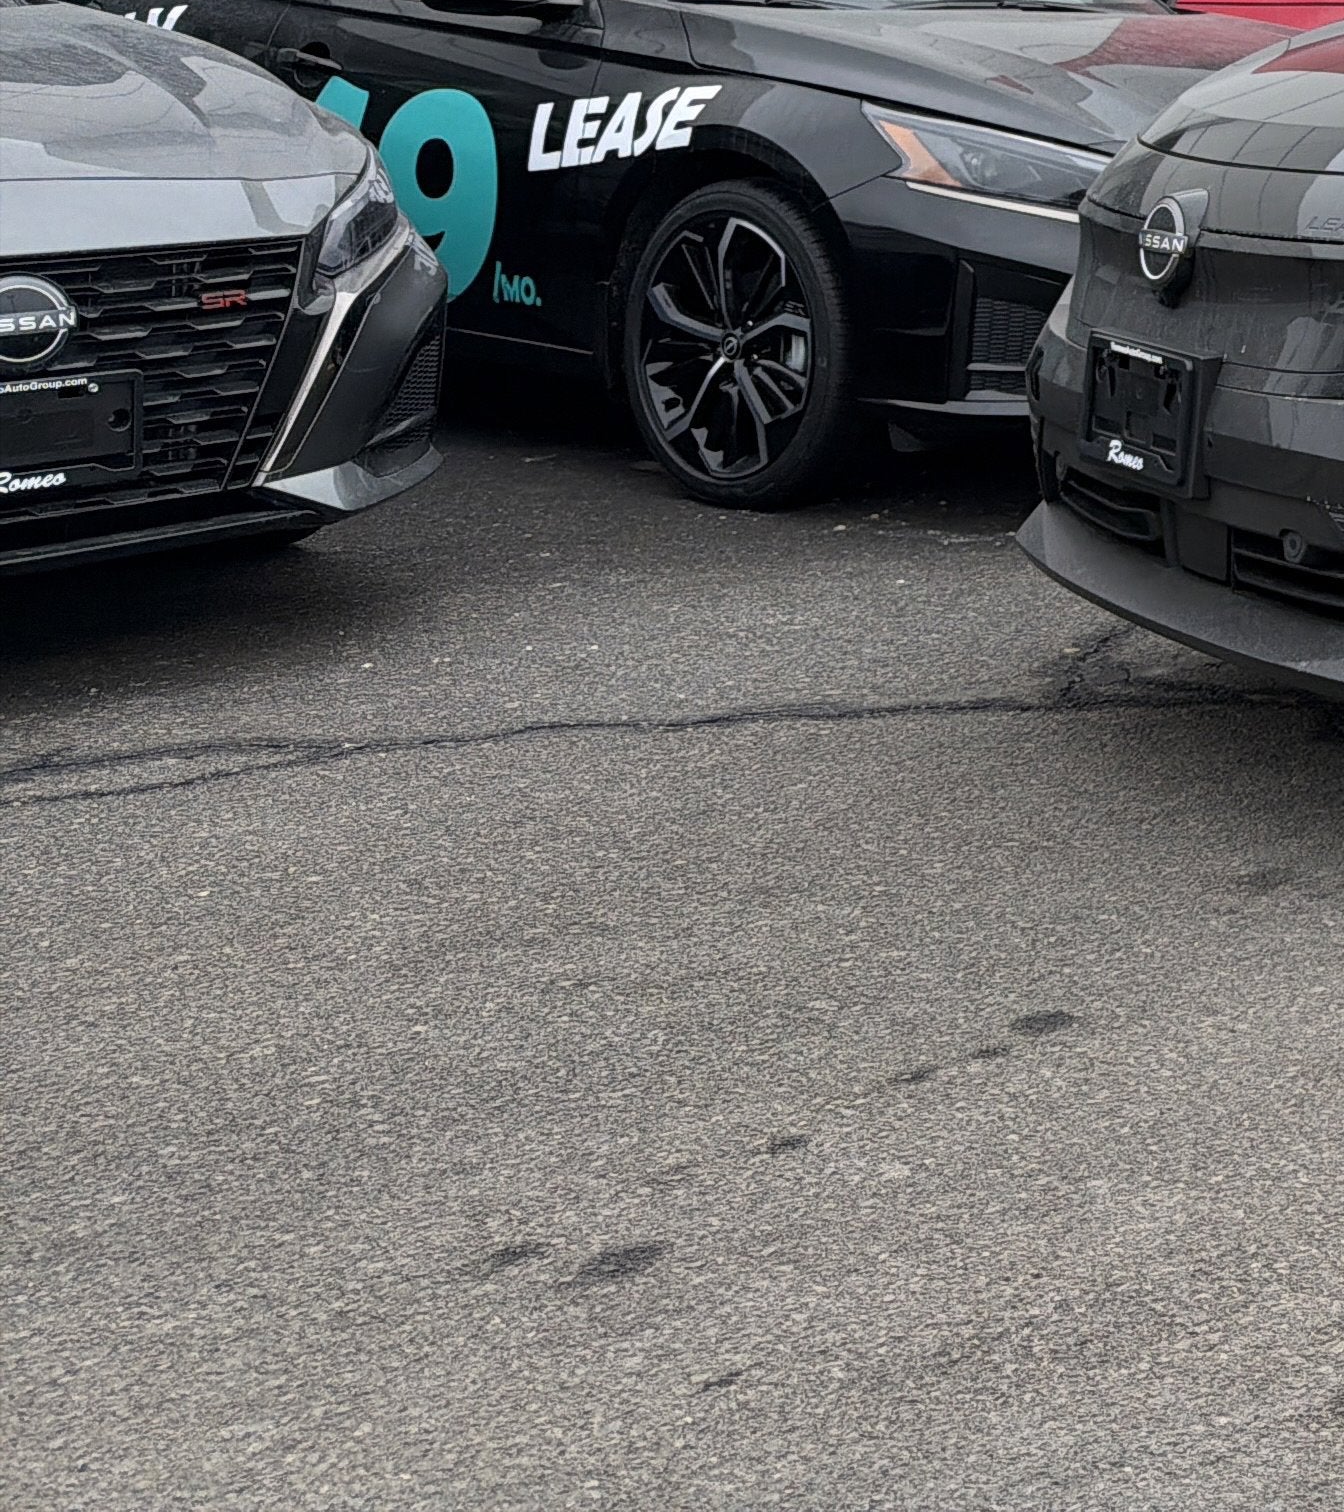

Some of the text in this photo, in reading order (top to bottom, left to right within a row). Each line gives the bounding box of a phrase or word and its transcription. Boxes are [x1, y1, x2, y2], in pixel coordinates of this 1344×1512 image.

[527, 85, 722, 172] LEASE
[201, 289, 248, 309] SR
[493, 260, 542, 307] /MO.
[1106, 439, 1144, 471] Romeo
